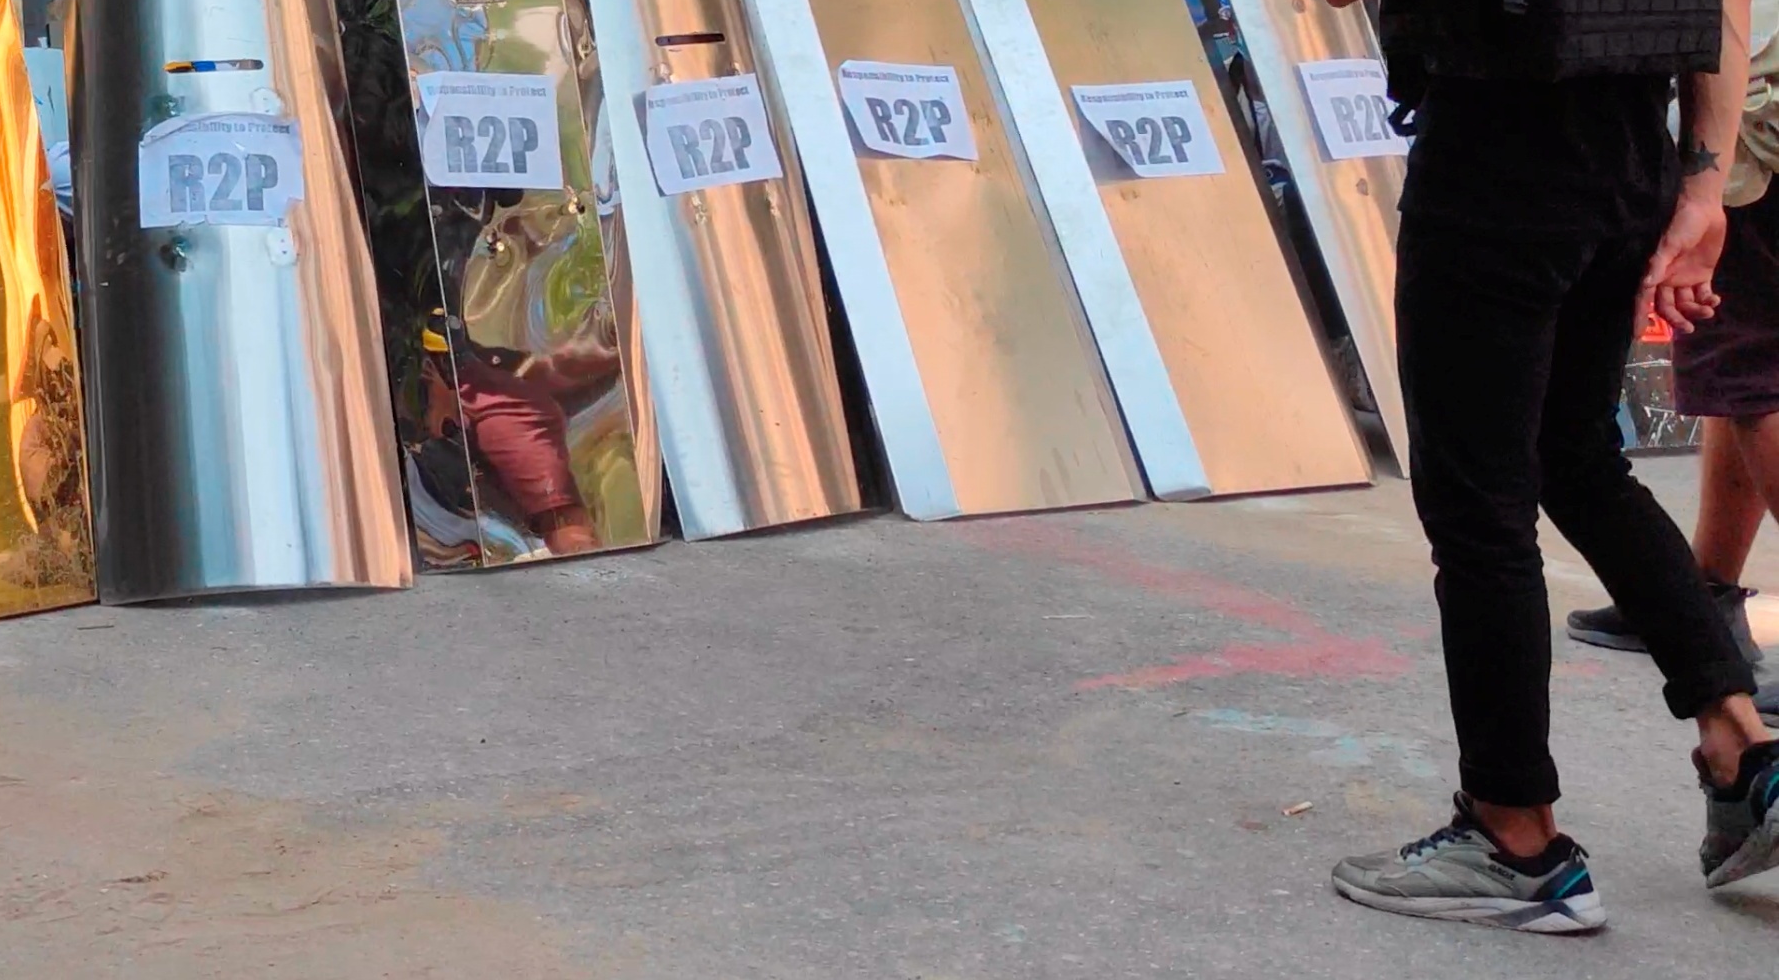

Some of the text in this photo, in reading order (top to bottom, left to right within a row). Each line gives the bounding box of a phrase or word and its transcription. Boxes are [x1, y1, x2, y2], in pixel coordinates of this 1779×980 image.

[444, 116, 539, 174] R2P
[865, 97, 952, 146] R2P
[1105, 116, 1192, 166] R2P
[1330, 94, 1391, 143] R2P
[666, 116, 752, 180] R2P
[168, 152, 279, 213] R2P
